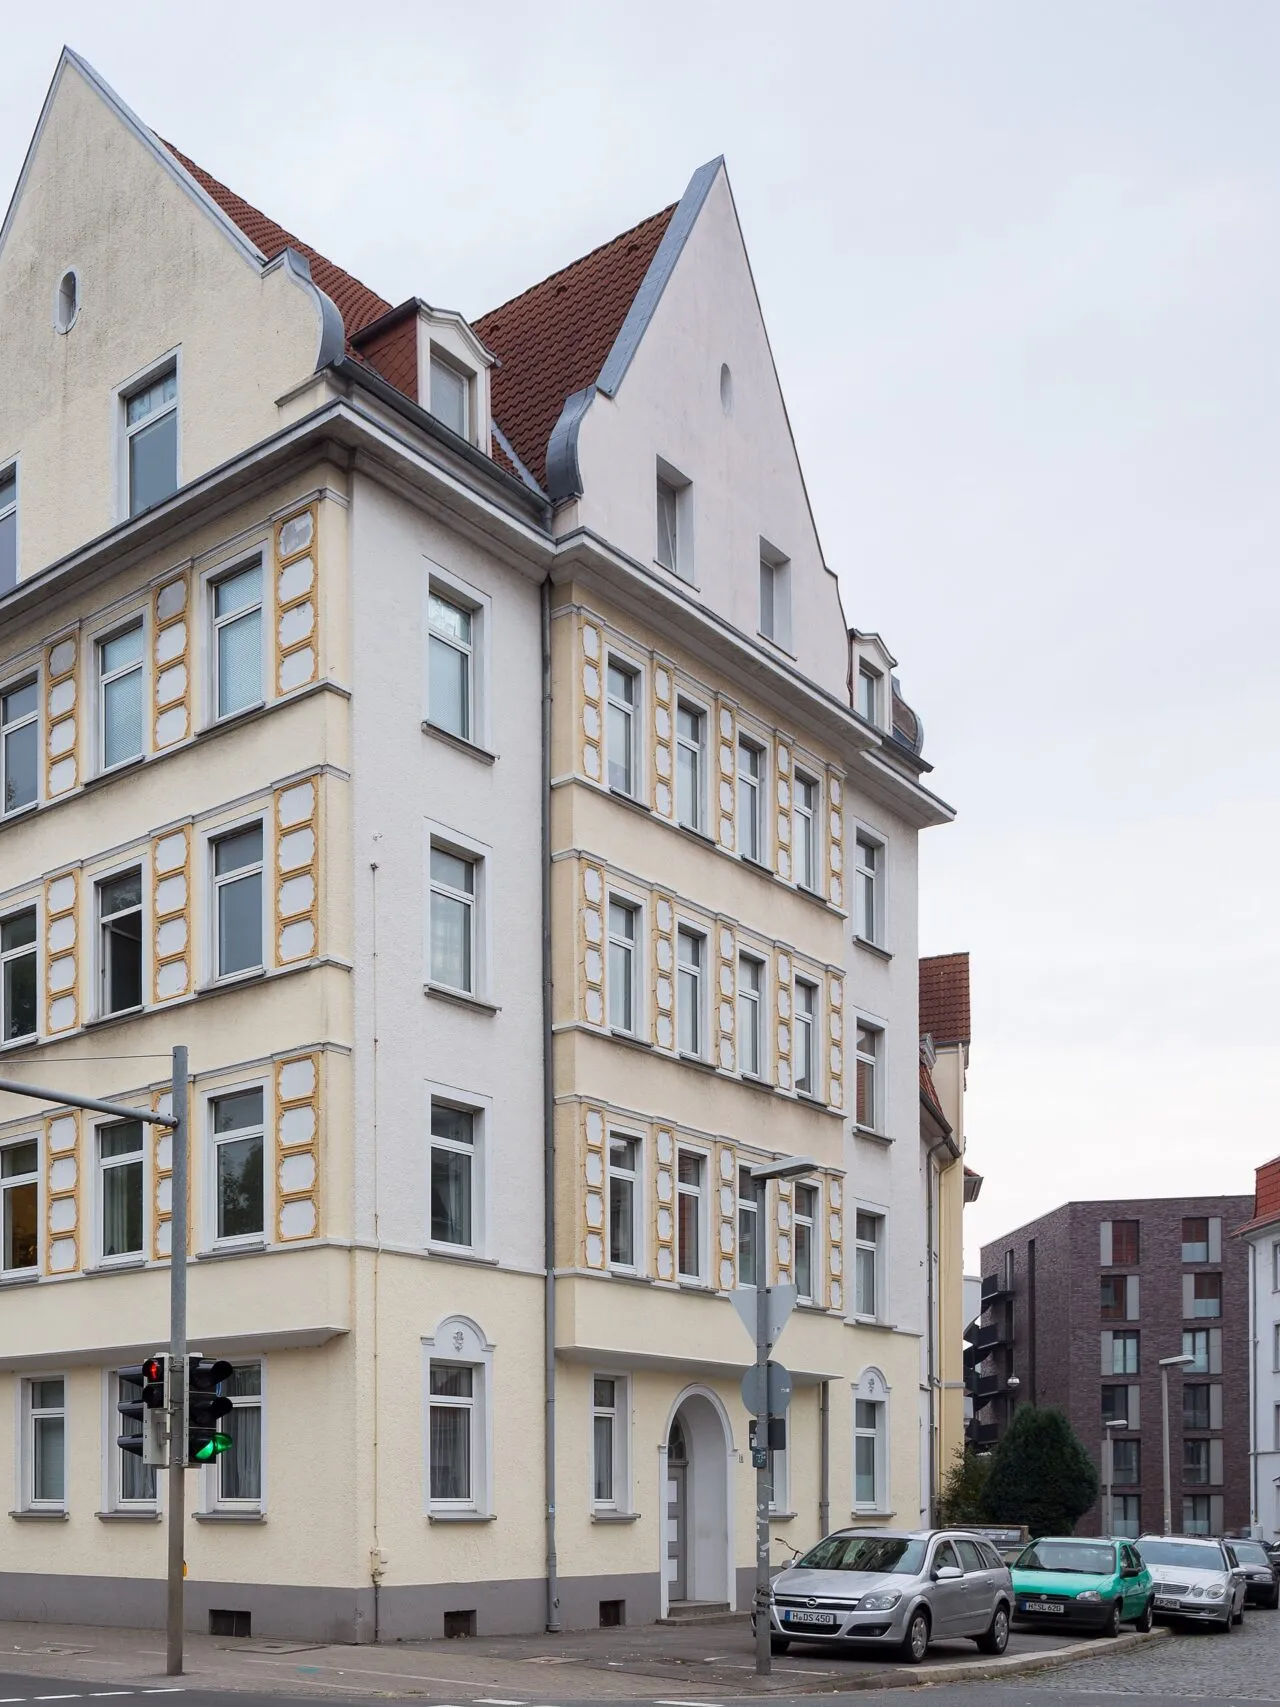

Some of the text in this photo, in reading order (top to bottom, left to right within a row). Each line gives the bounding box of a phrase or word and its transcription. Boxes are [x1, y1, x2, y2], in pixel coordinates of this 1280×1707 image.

[792, 1612, 830, 1623] H DS 450
